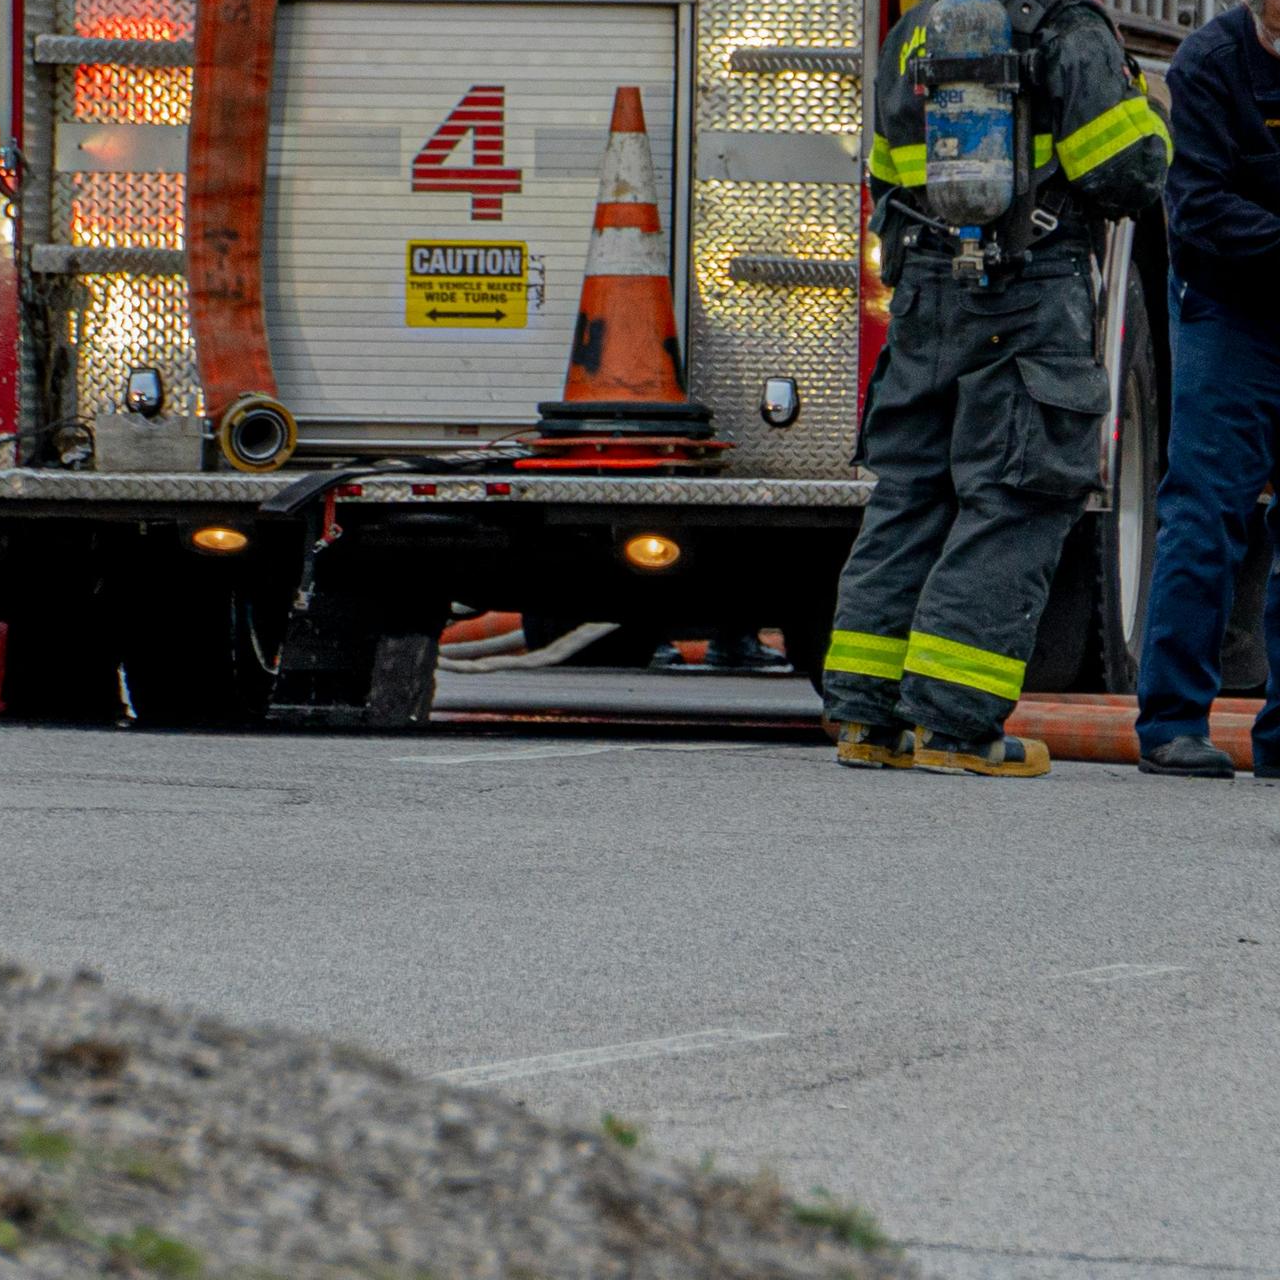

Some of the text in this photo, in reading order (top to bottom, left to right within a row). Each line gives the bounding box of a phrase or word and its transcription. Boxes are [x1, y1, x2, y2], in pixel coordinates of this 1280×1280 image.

[411, 85, 523, 221] 4
[413, 247, 521, 275] CAUTION
[410, 281, 523, 292] THIS VEHICLE MAKES
[425, 292, 508, 303] WIDE TURNS
